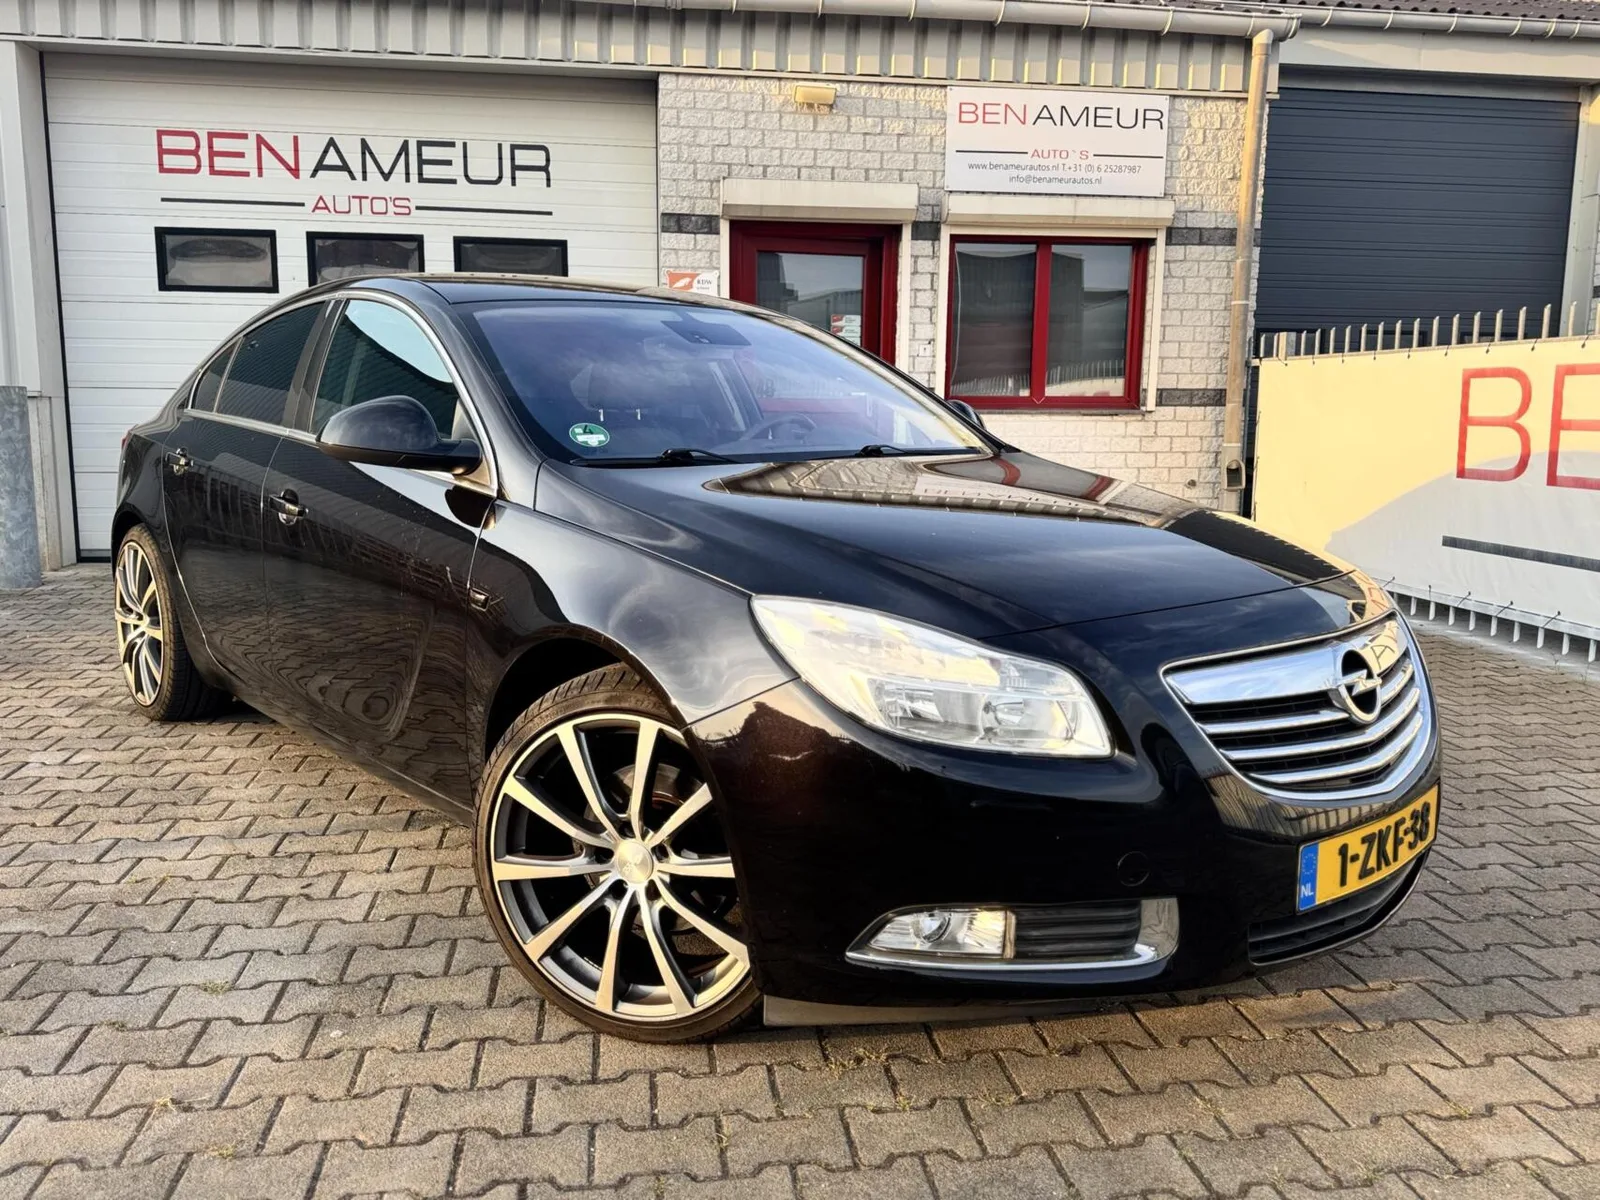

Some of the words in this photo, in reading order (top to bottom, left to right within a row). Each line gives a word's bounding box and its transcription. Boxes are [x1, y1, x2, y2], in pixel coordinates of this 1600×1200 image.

[968, 162, 1059, 172] www.benameurautos.nl
[1096, 164, 1102, 173] 6
[1008, 175, 1102, 185] info@benameurautos.nl
[311, 194, 412, 216] AUTO'S
[1339, 803, 1430, 887] 1-ZKF-38
[1300, 883, 1314, 899] NL
